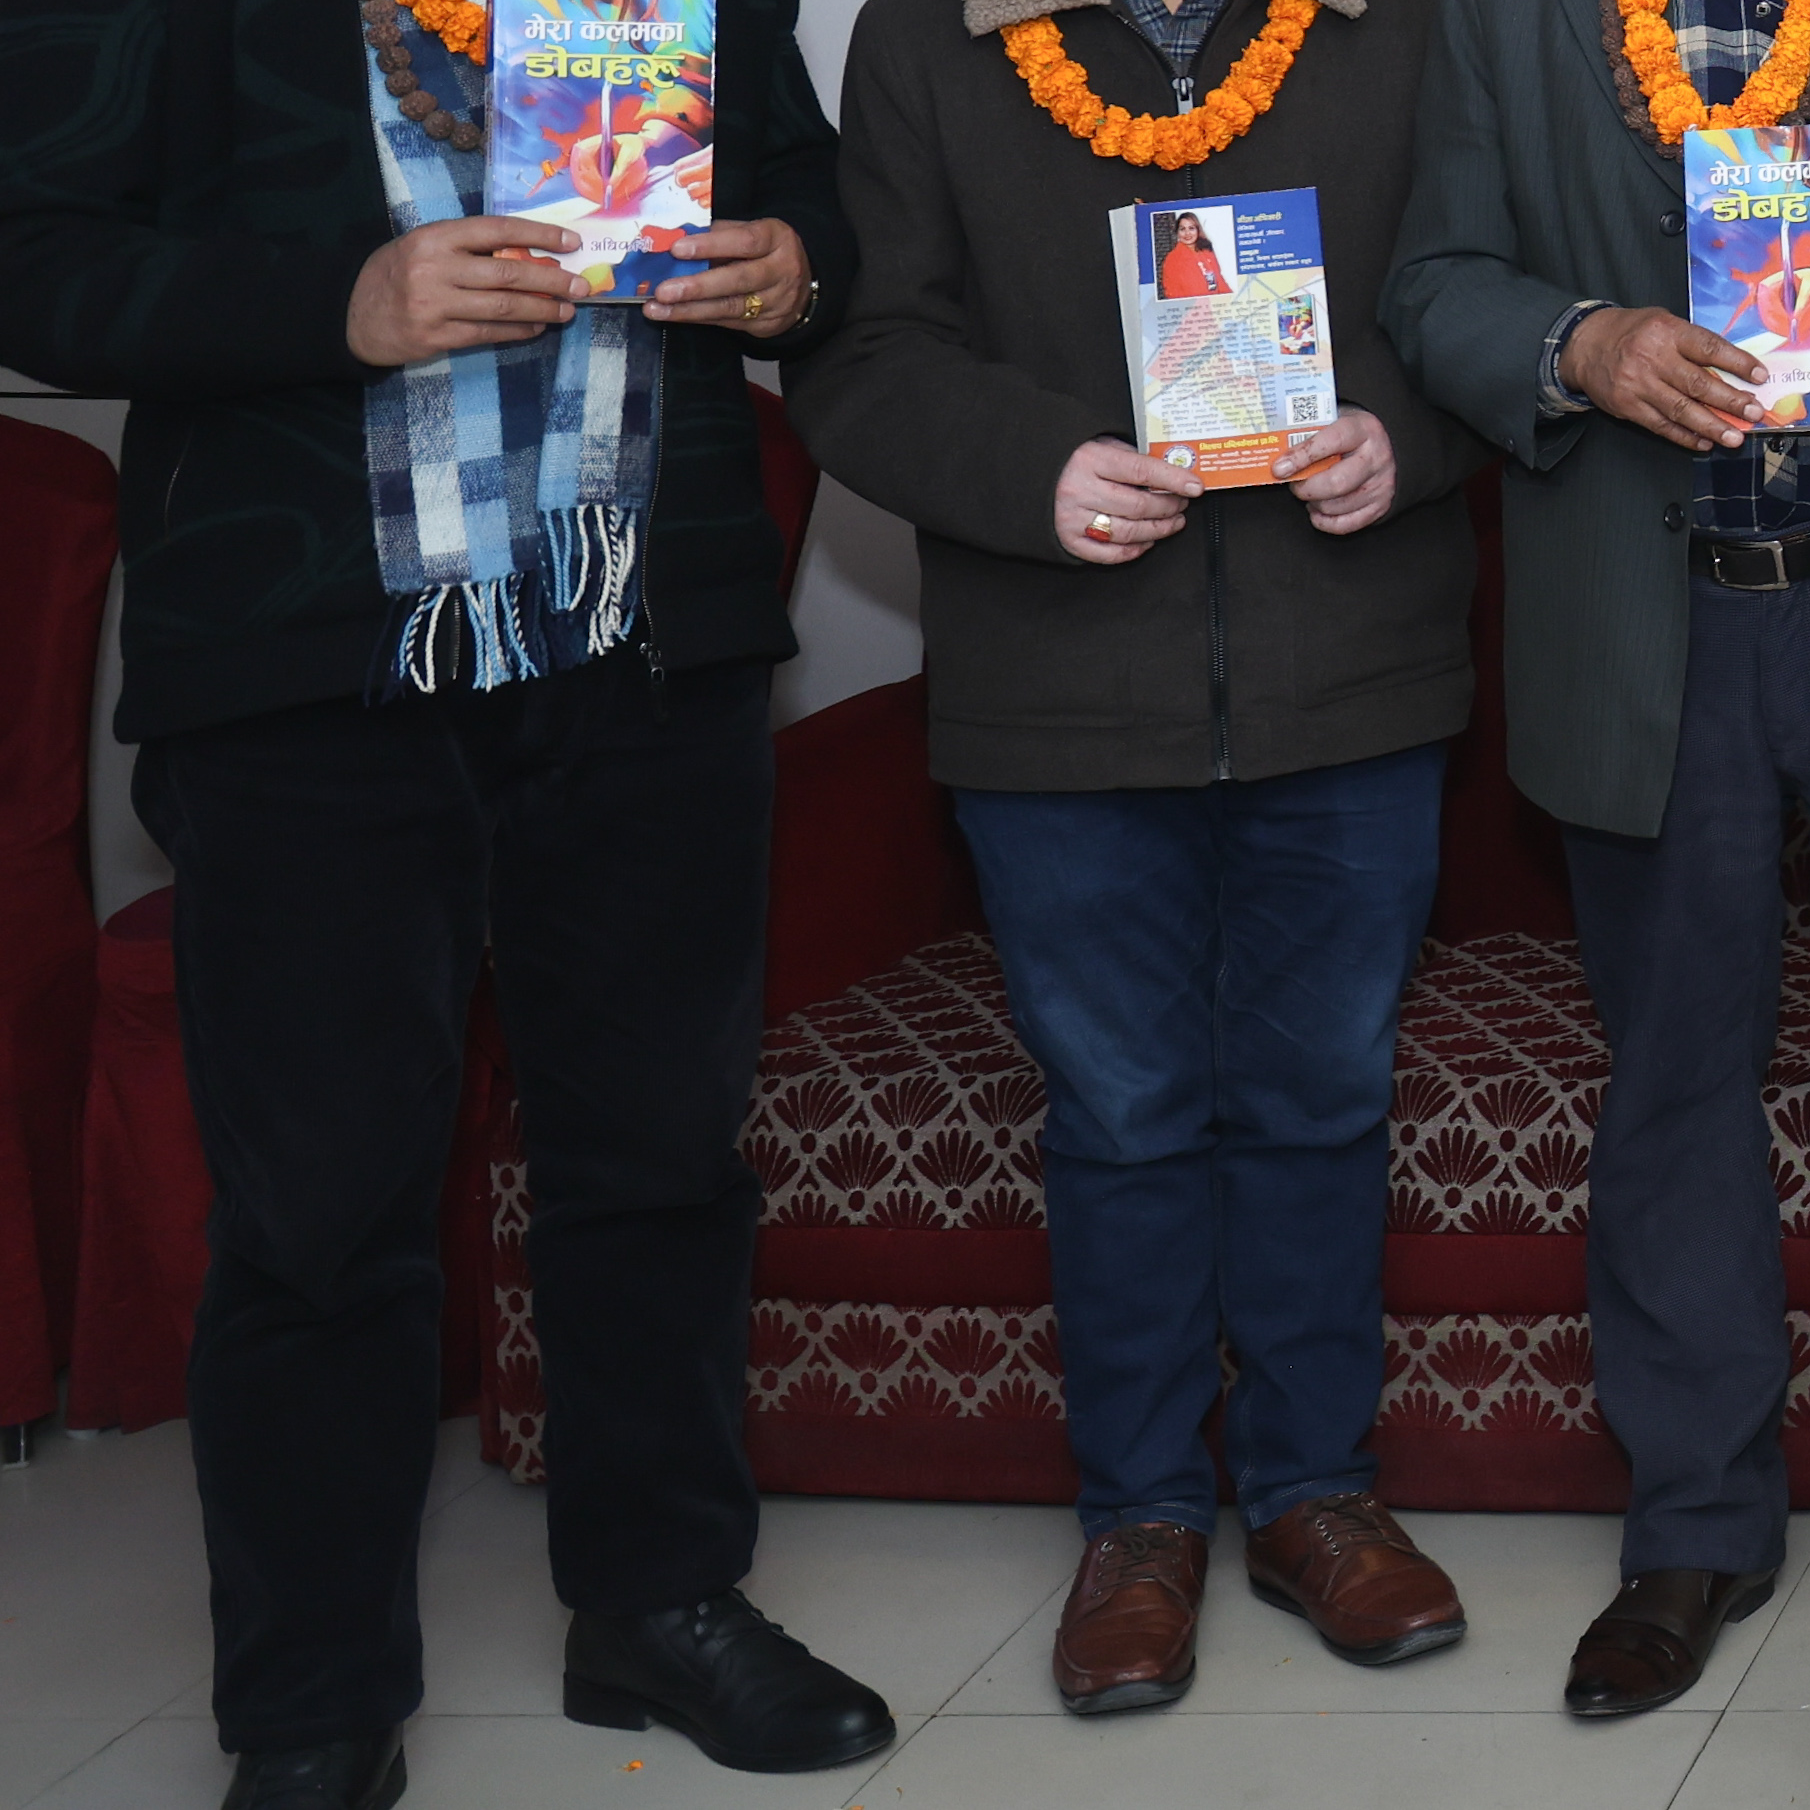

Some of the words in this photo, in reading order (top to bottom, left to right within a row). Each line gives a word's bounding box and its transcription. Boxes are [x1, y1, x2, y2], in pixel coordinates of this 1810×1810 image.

[524, 13, 573, 43] मेरा
[580, 19, 686, 42] कलमका
[524, 44, 686, 88] डोबहरू
[1709, 160, 1751, 187] मेरा
